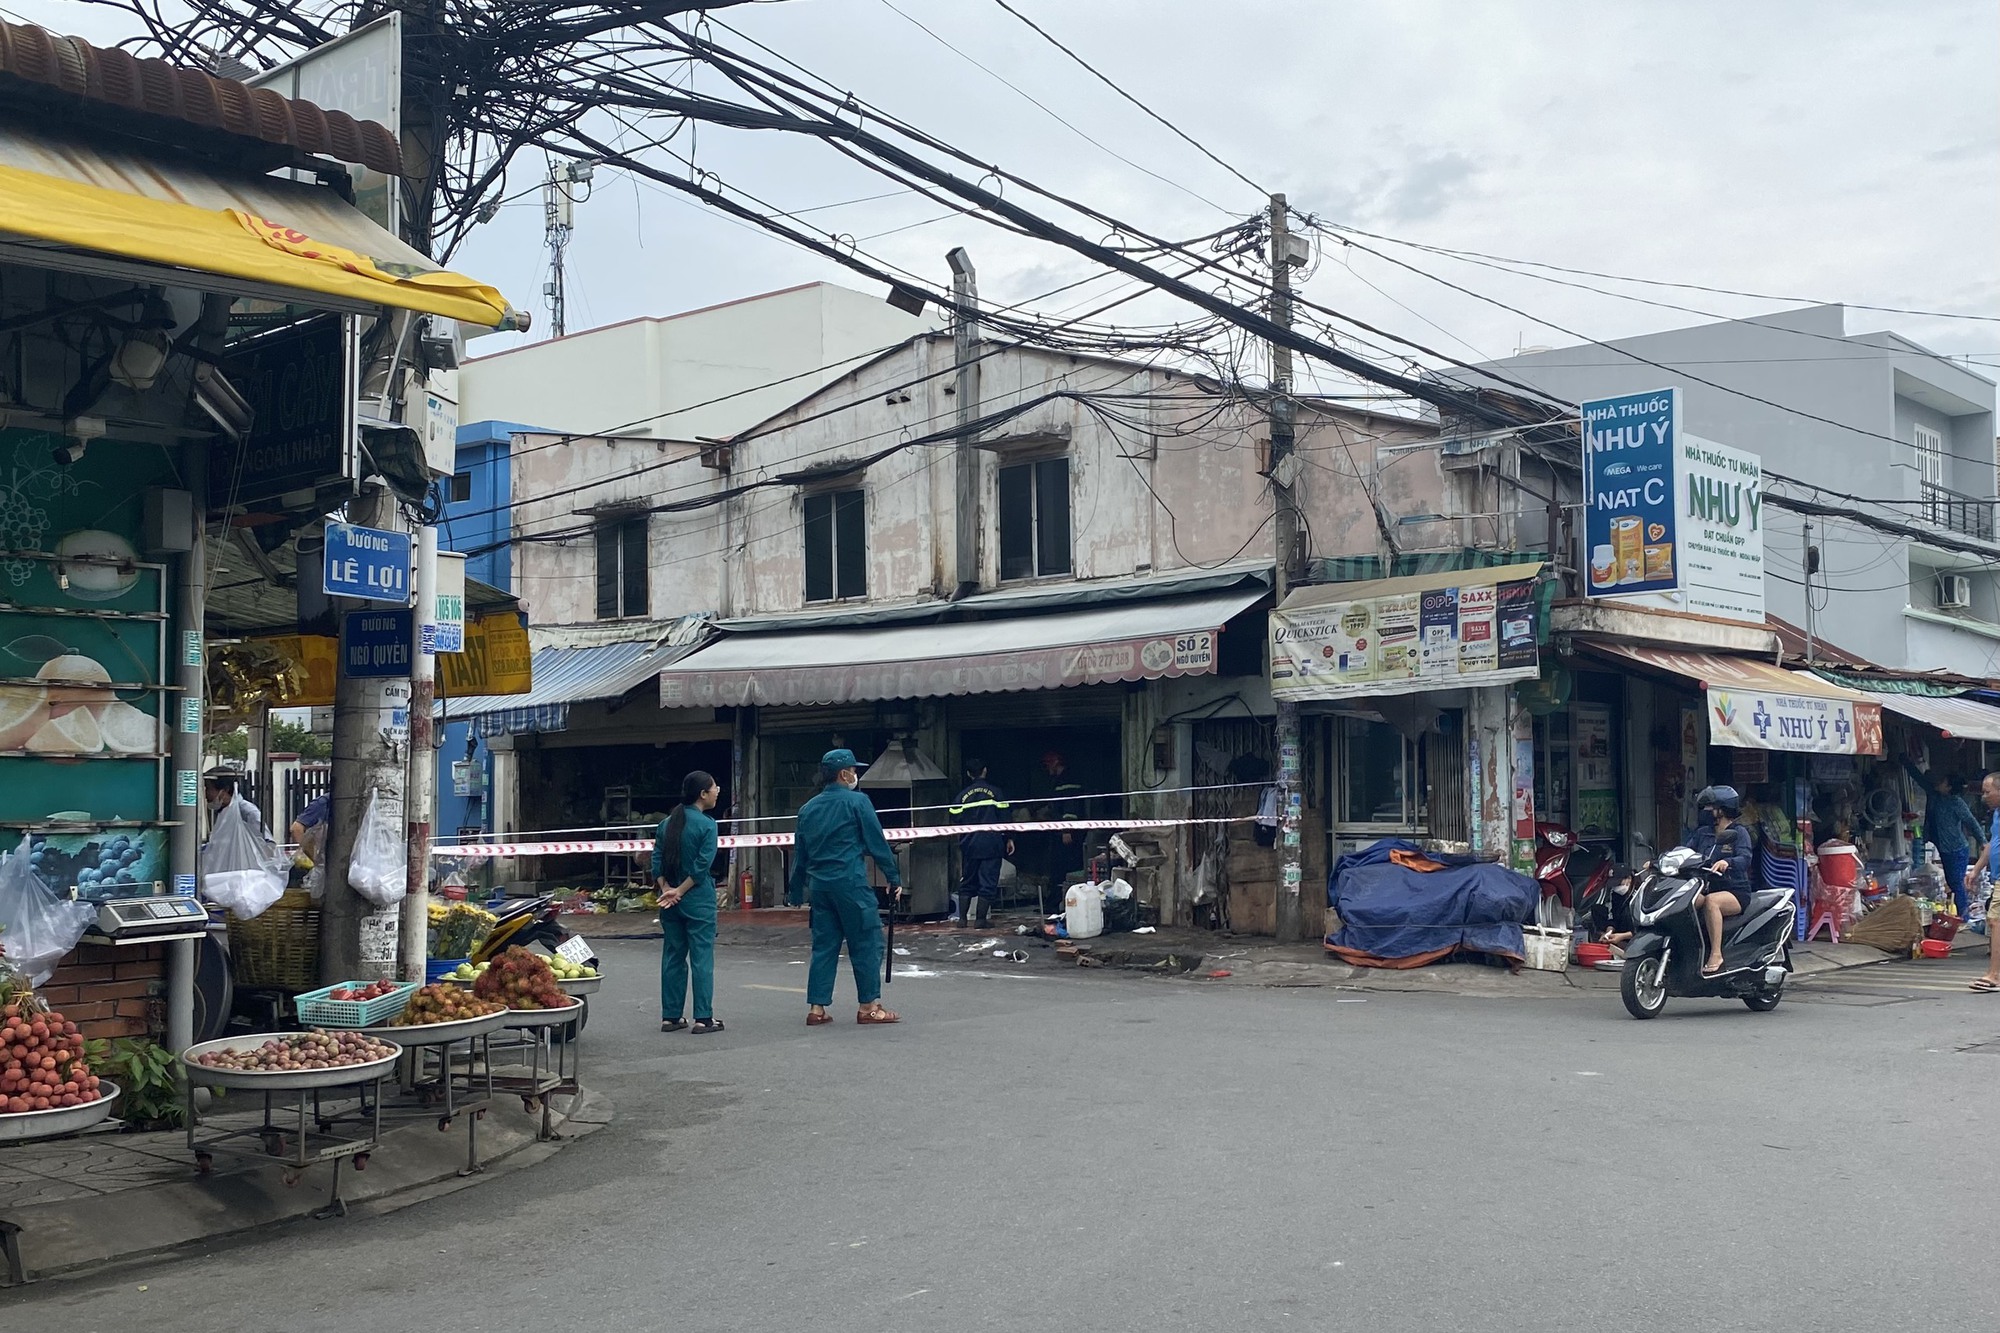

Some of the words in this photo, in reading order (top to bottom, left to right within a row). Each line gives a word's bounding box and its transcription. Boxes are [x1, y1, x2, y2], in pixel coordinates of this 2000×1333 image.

[1588, 405, 1617, 421] NHÀ
[1619, 396, 1668, 417] THUỐC
[1586, 422, 1647, 453] NHƯ
[1651, 416, 1670, 444] Ý
[1606, 466, 1631, 476] MEGA
[1637, 464, 1647, 472] We
[1648, 463, 1662, 471] care
[1685, 444, 1701, 462] NHÀ
[1702, 450, 1726, 469] THUỐC
[1728, 458, 1738, 472] TƯ
[1740, 462, 1758, 478] NHÂN
[1598, 488, 1641, 511] NAT
[1644, 477, 1664, 505] C
[1687, 473, 1741, 527] NHƯ
[1745, 481, 1762, 530] Ý
[347, 531, 388, 552] ĐƯỜNG
[1704, 529, 1714, 541] ĐẠT
[332, 558, 358, 583] LÊ
[368, 564, 402, 592] LỢI
[1423, 596, 1454, 609] OPP
[1461, 591, 1492, 604] SAXX
[362, 615, 396, 631] ĐƯỜNG
[1177, 635, 1195, 652] SỐ
[1200, 637, 1209, 650] 2
[1275, 624, 1338, 644] QUICKSTICK
[351, 642, 369, 665] NGÔ
[374, 637, 407, 667] QUYỀN
[1099, 654, 1113, 667] 277
[1176, 653, 1190, 665] NGÔ
[1191, 649, 1210, 664] QUYỀN
[1778, 717, 1813, 739] NHƯ
[1817, 715, 1828, 740] Ý
